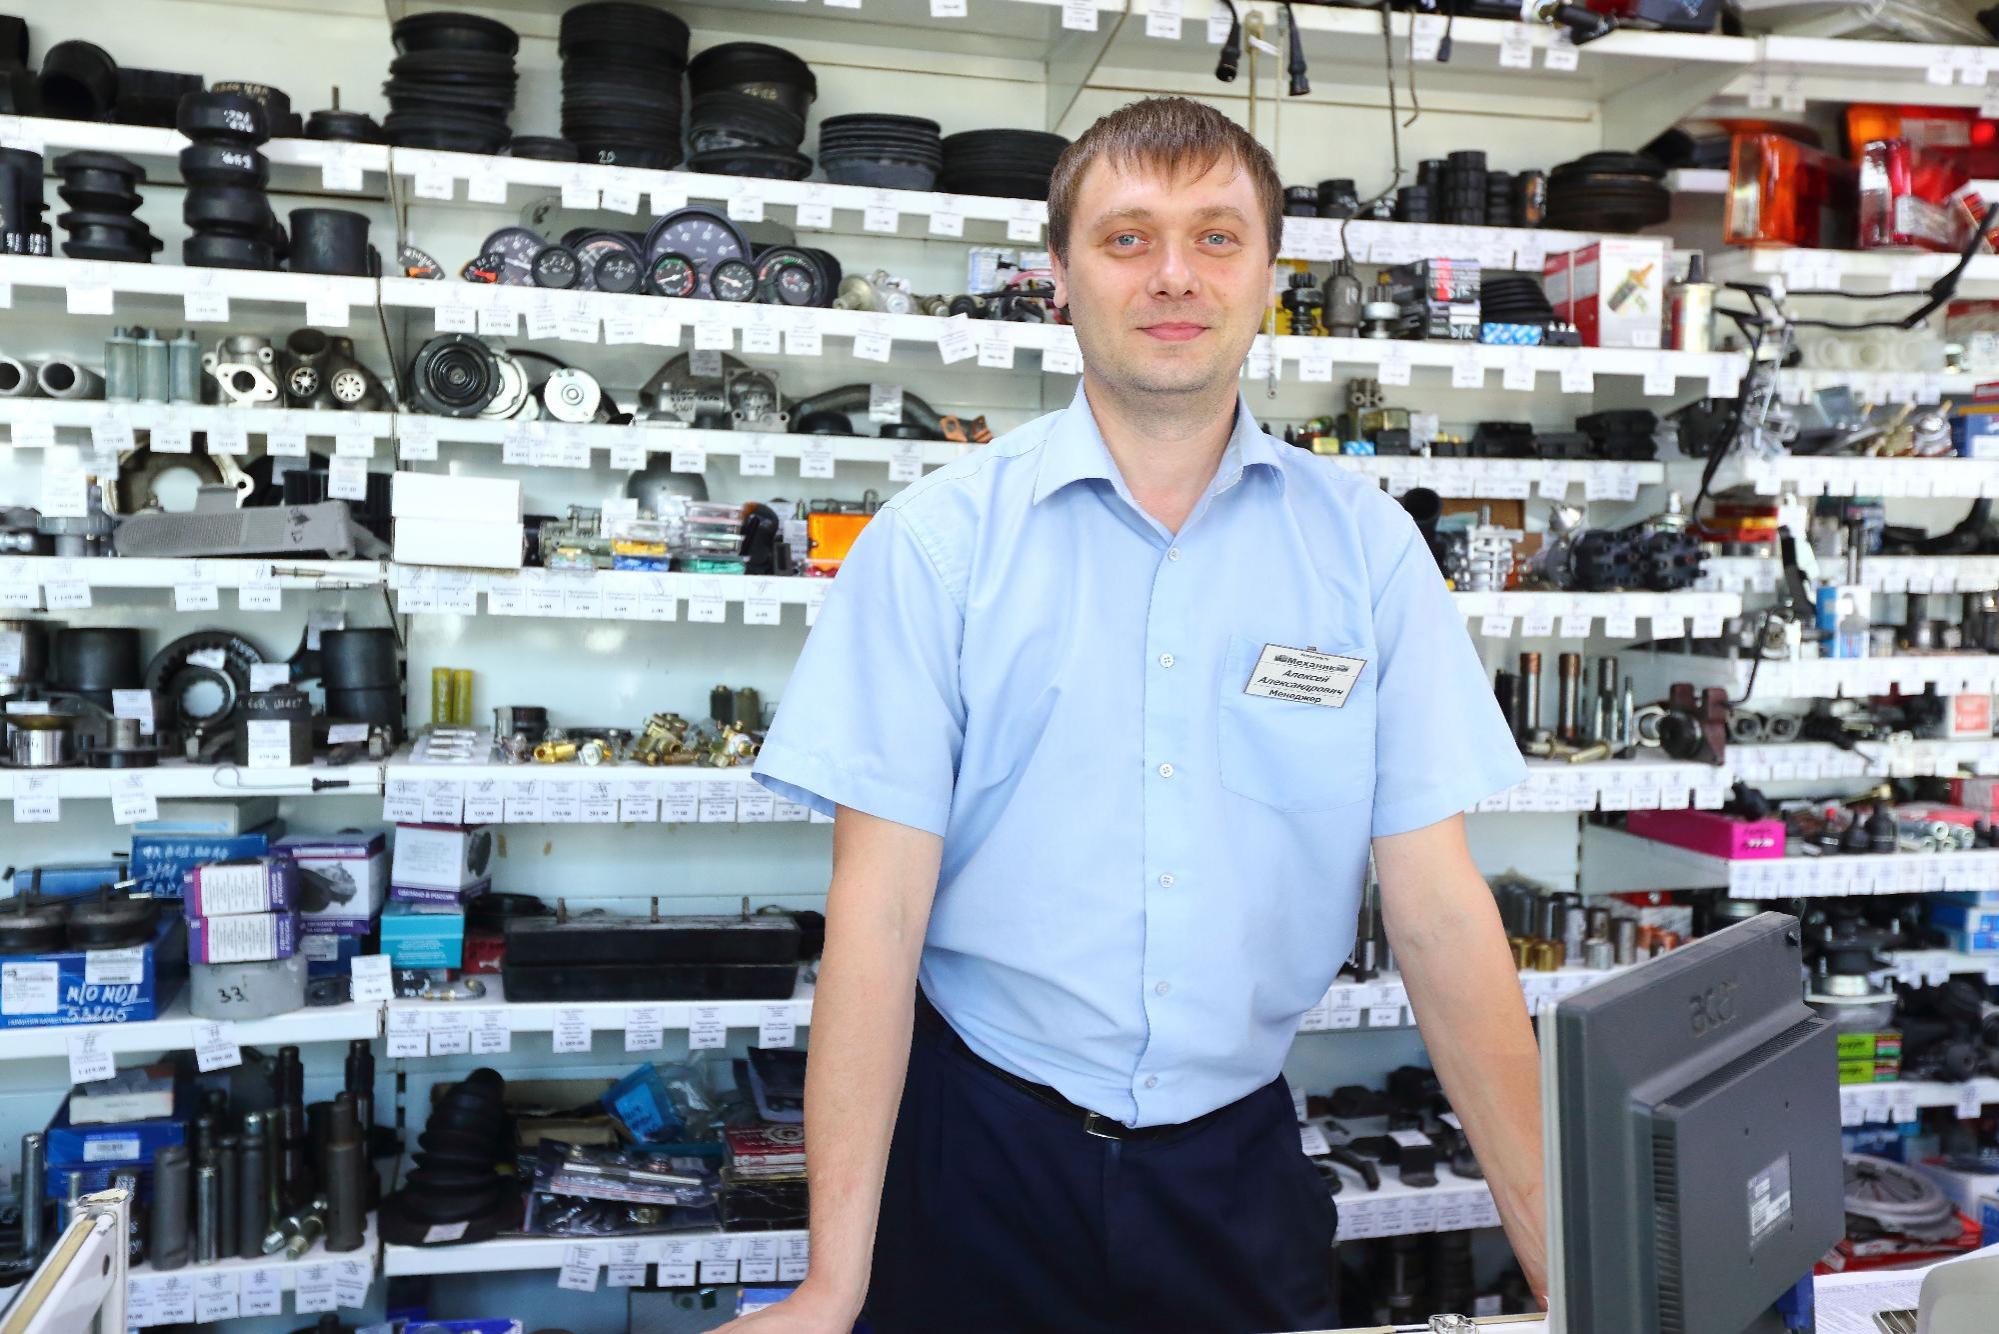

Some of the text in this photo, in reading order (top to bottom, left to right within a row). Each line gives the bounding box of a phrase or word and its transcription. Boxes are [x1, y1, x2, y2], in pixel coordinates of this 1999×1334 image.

[1287, 657, 1336, 671] Механик
[1282, 669, 1330, 683] Алексей
[1257, 676, 1343, 694] Александрович
[1268, 689, 1321, 704] Менеджер
